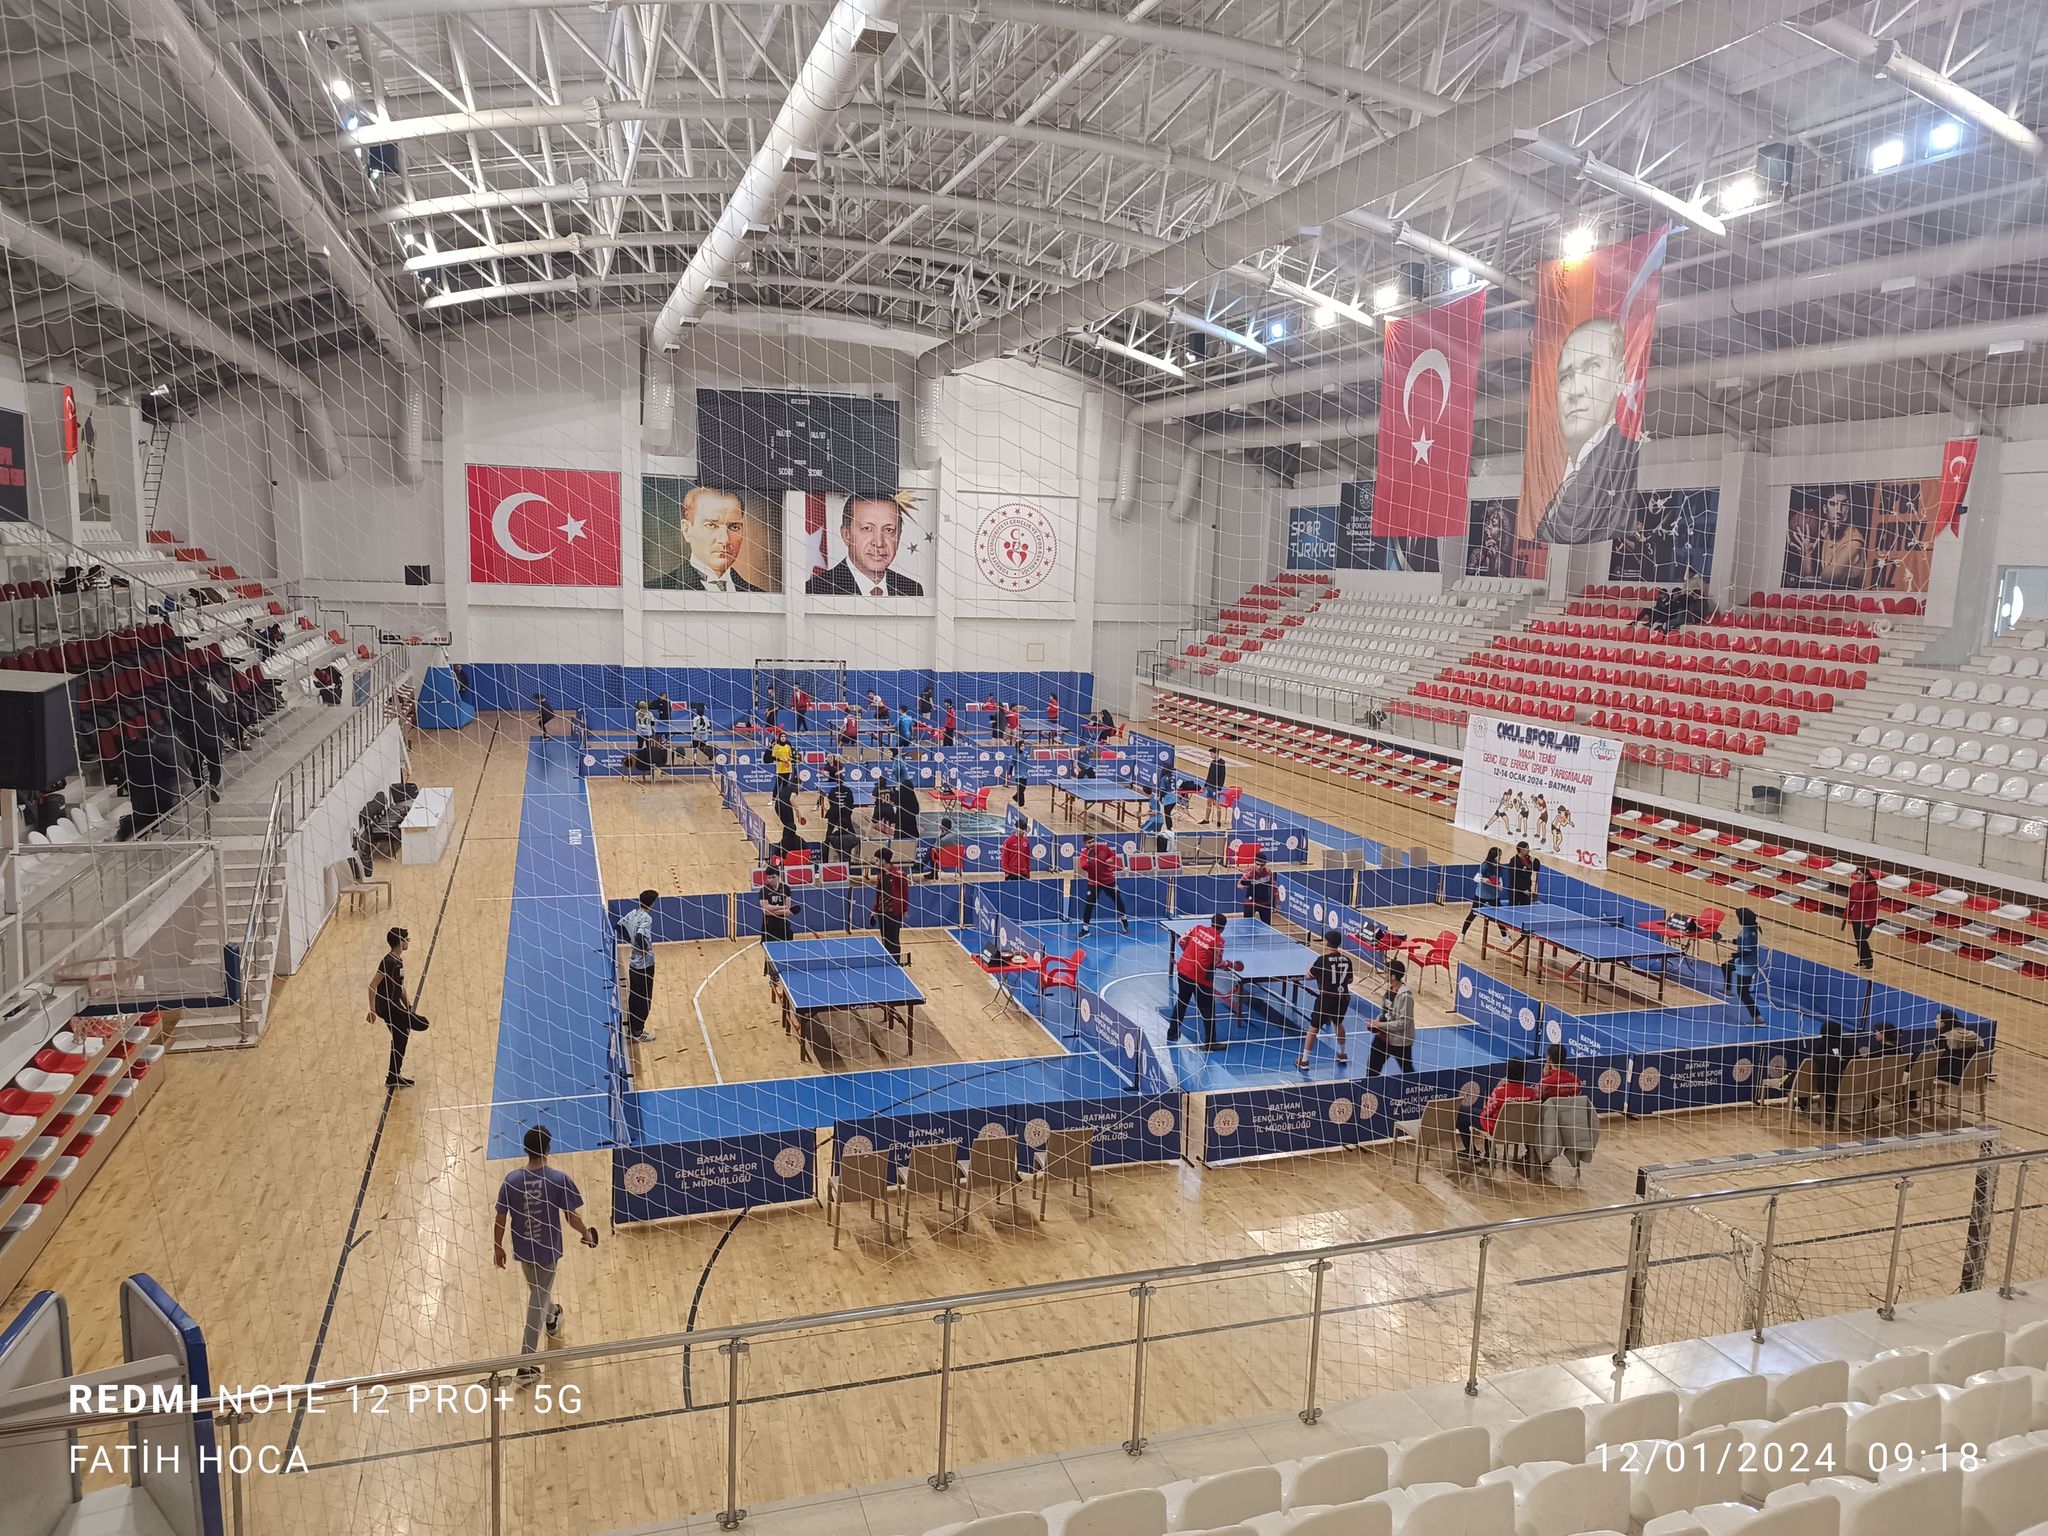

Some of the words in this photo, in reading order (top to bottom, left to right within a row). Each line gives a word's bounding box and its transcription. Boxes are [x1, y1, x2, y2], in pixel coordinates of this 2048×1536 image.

[778, 468, 794, 476] SCORE
[808, 468, 822, 477] SCORE
[1290, 540, 1336, 558] TÜRKİYE
[1520, 748, 1535, 760] MASA
[1510, 758, 1529, 772] ERKEK
[1532, 764, 1548, 775] GRUP
[1494, 768, 1508, 778] 12-14
[1508, 771, 1527, 782] OCAK
[1527, 776, 1544, 786] 2024
[1548, 780, 1577, 794] BATMAN
[1331, 962, 1348, 984] 17
[1406, 1086, 1434, 1094] BATMAN
[1270, 1102, 1300, 1110] BATMAN
[1084, 1112, 1117, 1122] BATMAN
[1252, 1112, 1284, 1123] GENÇLİK
[1296, 1110, 1316, 1118] SPOR
[1114, 1122, 1134, 1130] SPOR
[909, 1127, 944, 1138] BATMAN
[696, 1153, 736, 1164] BATMAN
[675, 1166, 716, 1179] GENÇLİK
[733, 1162, 758, 1172] SPOR
[681, 1181, 690, 1190] İL
[692, 1173, 752, 1188] MÜDÜRLÜĞÜ
